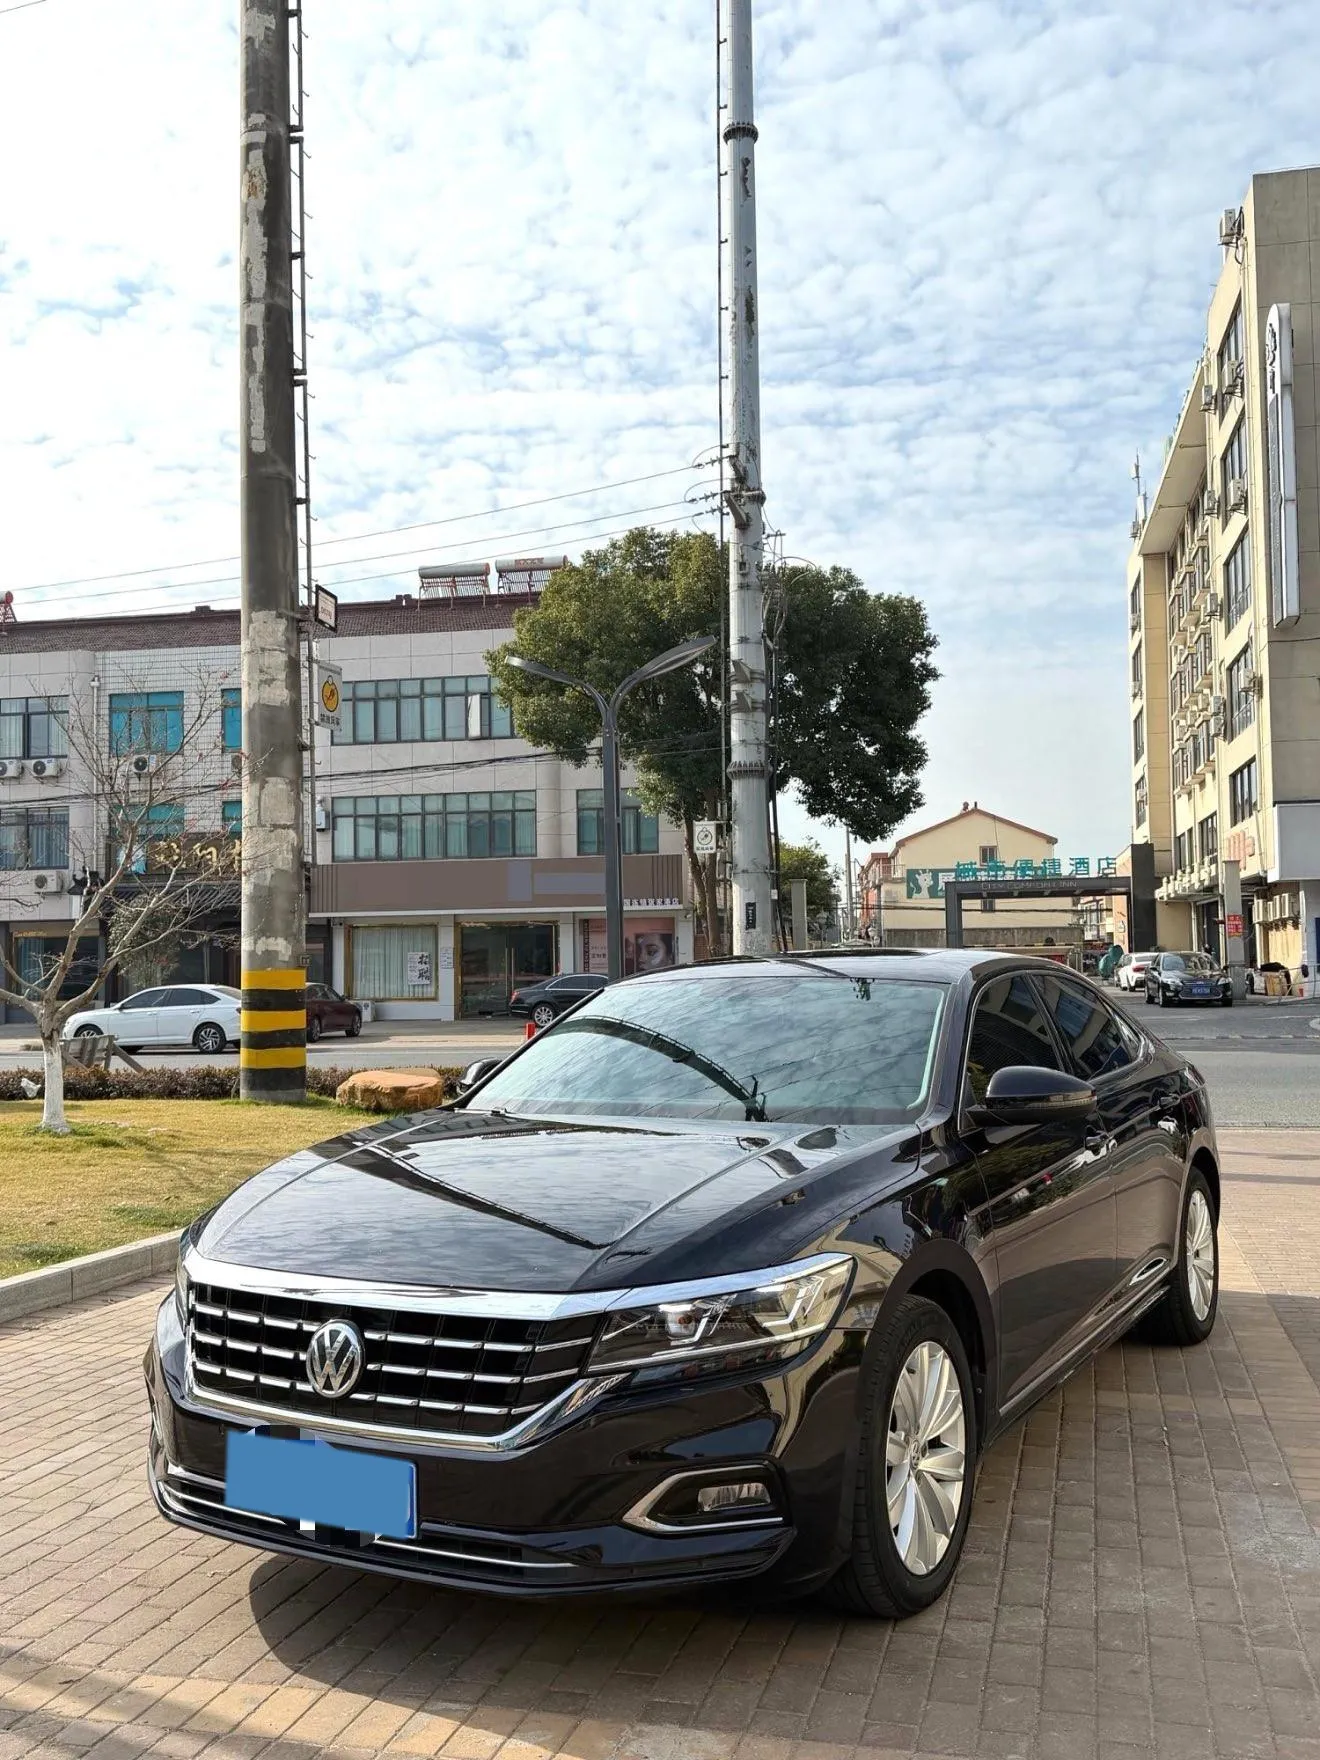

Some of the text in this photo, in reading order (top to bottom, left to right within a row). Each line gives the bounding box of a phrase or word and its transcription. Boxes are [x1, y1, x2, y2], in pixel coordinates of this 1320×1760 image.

[955, 857, 1117, 880] 城市便捷酒店
[1060, 880, 1078, 888] INN
